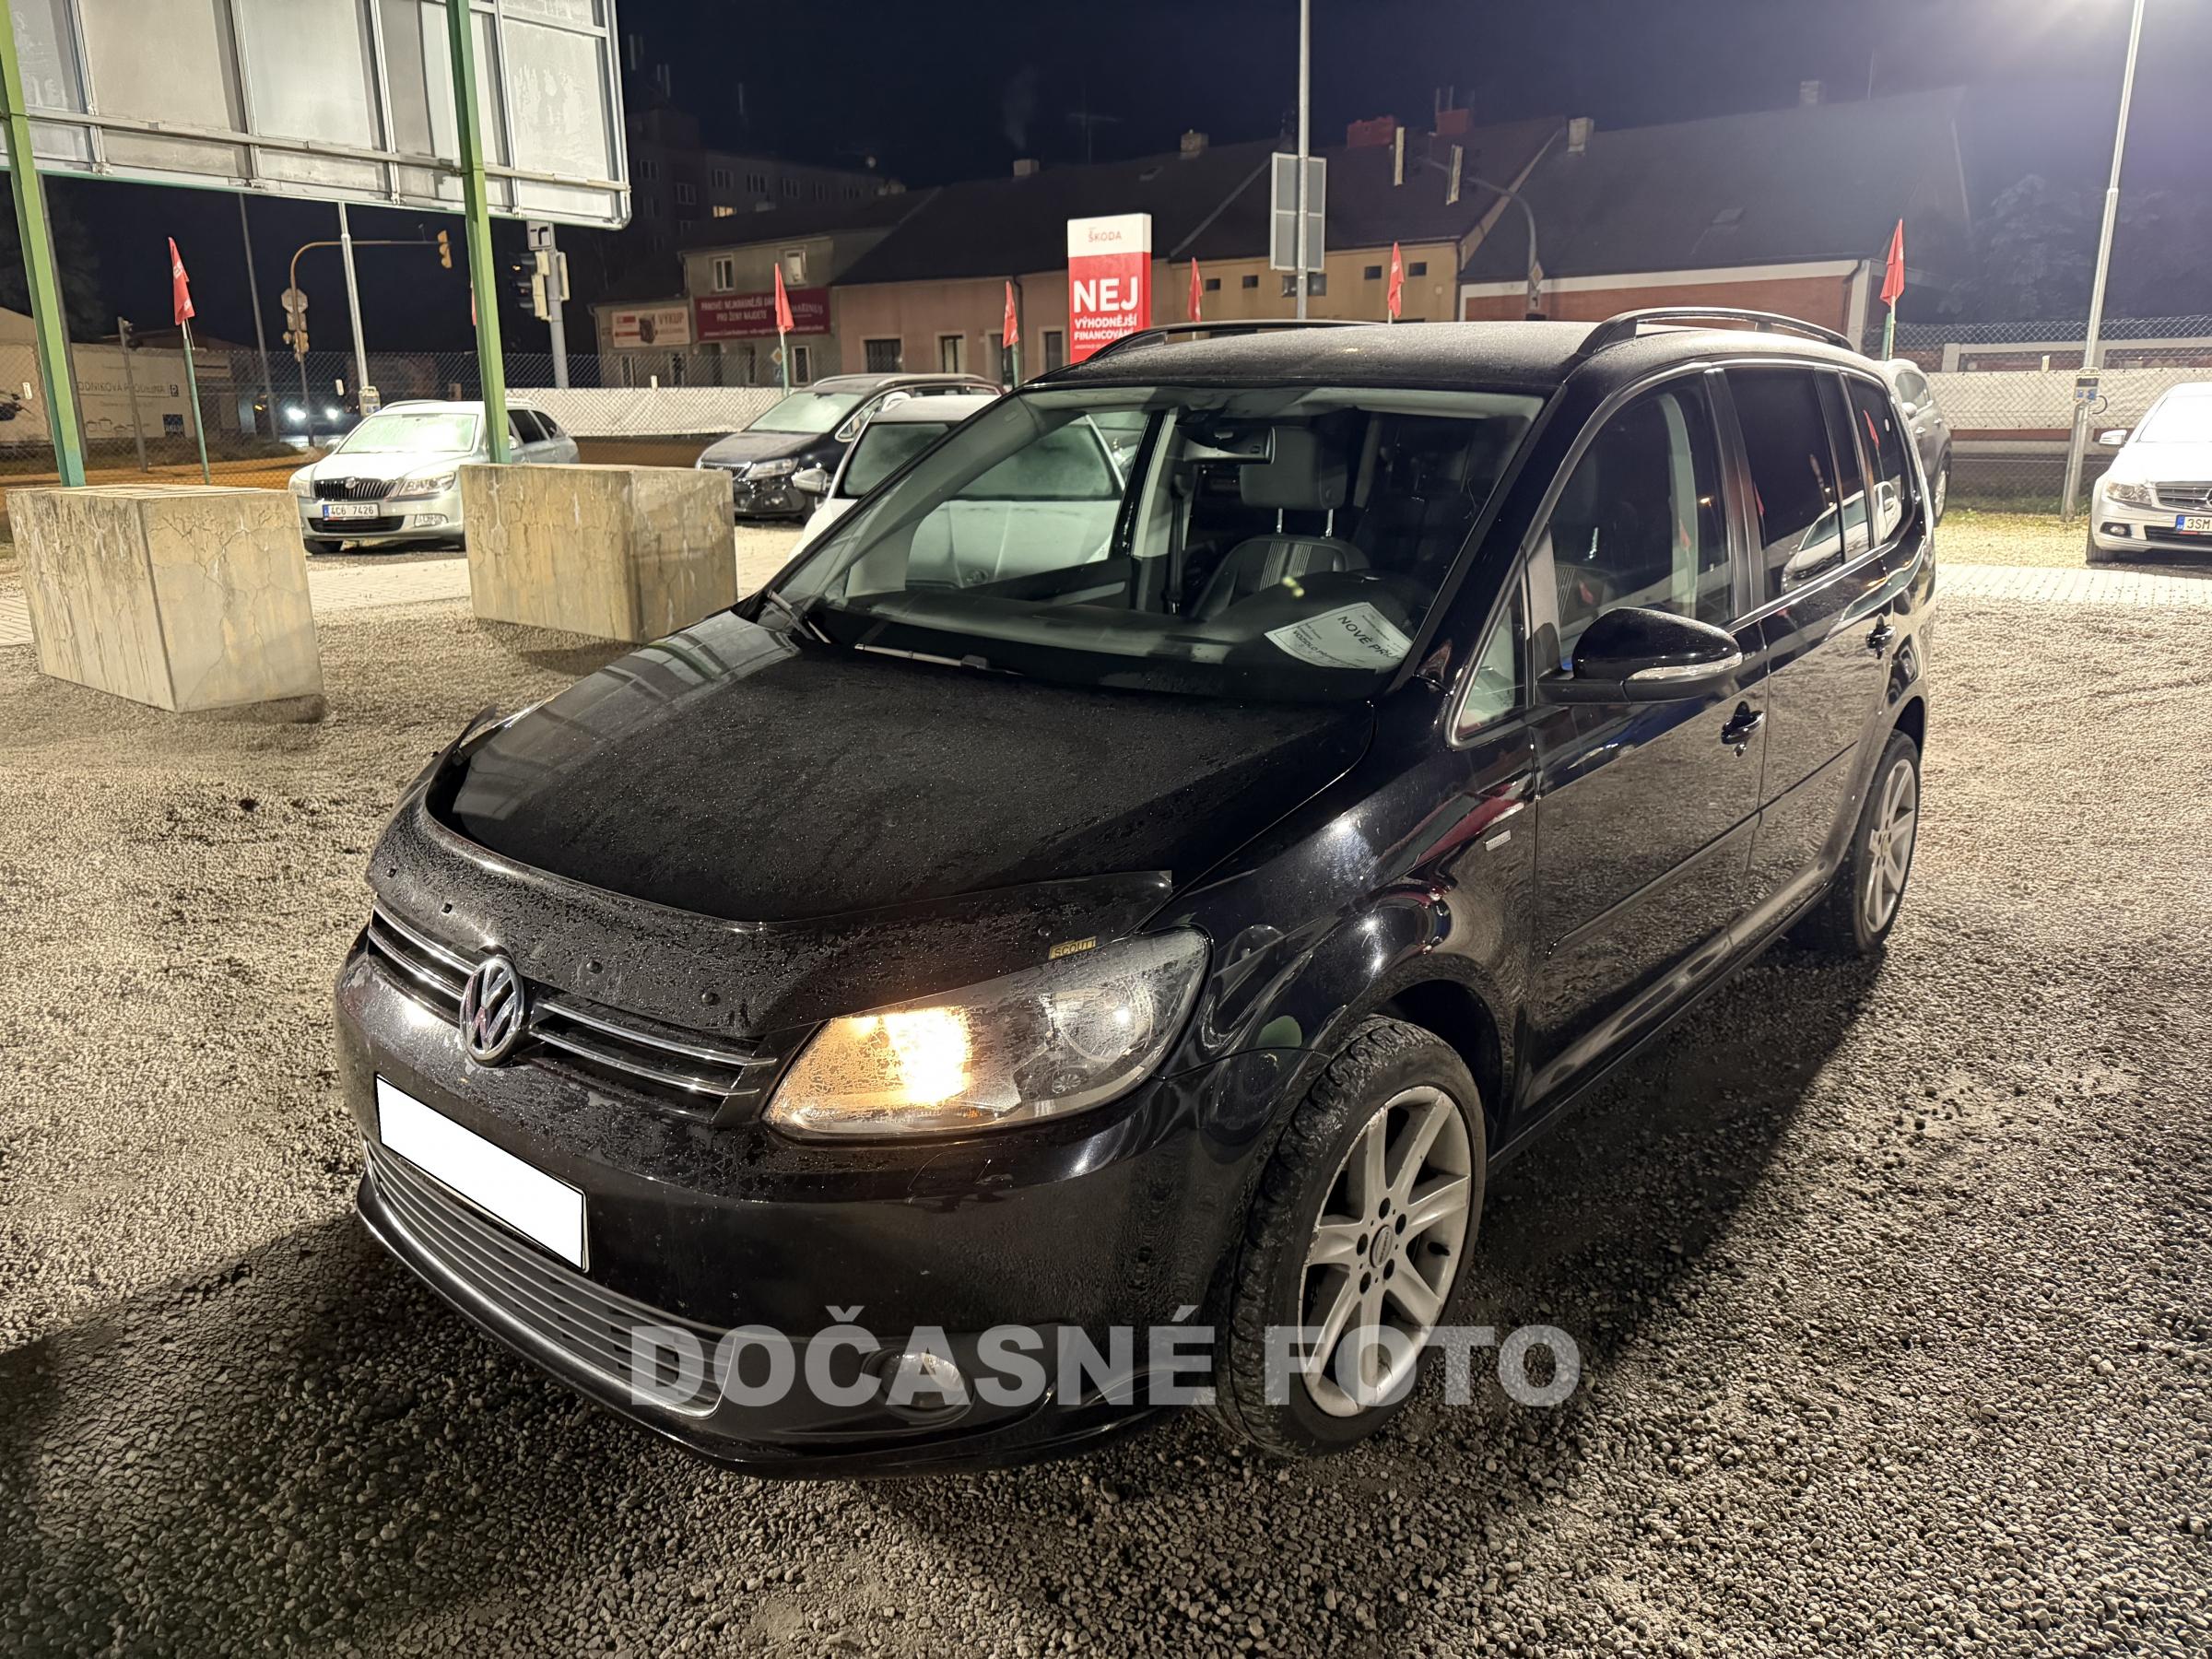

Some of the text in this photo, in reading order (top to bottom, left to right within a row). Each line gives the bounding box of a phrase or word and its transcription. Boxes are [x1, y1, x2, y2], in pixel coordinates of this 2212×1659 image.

[1088, 229, 1123, 242] ŠKODA
[1074, 276, 1138, 312] NEJ
[1074, 312, 1137, 329] VÝHODNĚJŠÍ
[331, 506, 374, 515] 4C6 7426
[2187, 518, 2210, 530] 3SM
[1337, 616, 1373, 644] NOVÉ
